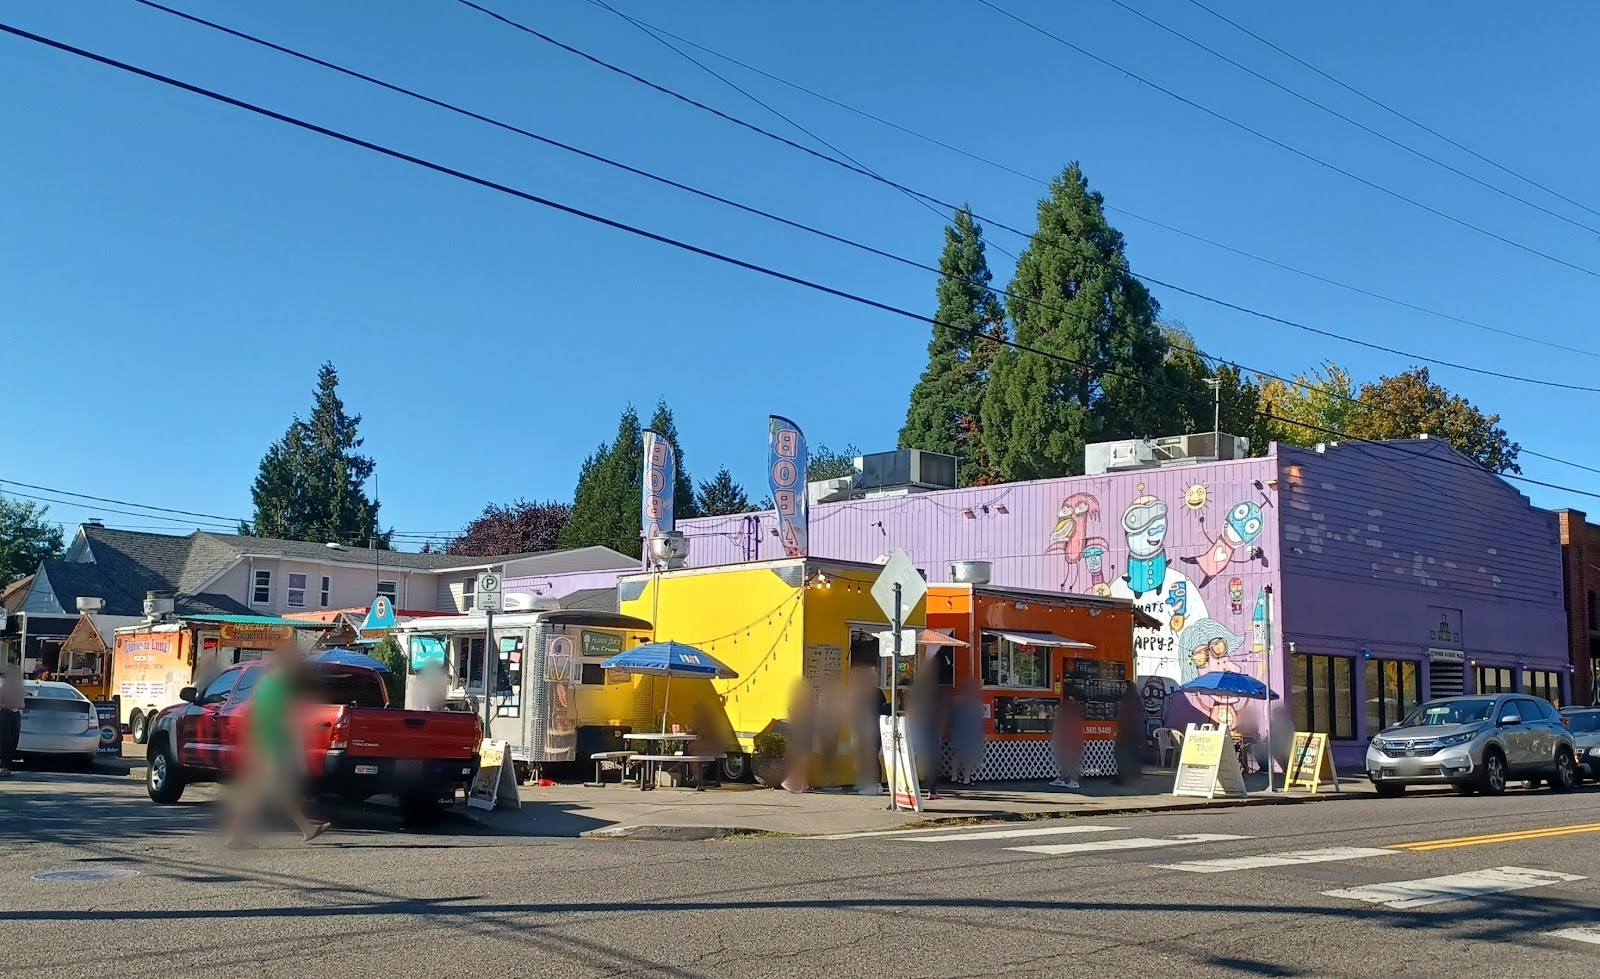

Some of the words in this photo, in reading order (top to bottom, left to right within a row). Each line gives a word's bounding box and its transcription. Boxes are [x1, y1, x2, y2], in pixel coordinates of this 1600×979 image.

[486, 578, 494, 588] P
[232, 623, 265, 632] MEXICAN
[124, 639, 151, 654] Taqueria
[151, 638, 168, 654] Luna
[1133, 635, 1174, 651] APPY?
[1188, 735, 1211, 743] Pinto
[1196, 744, 1214, 752] Thai
